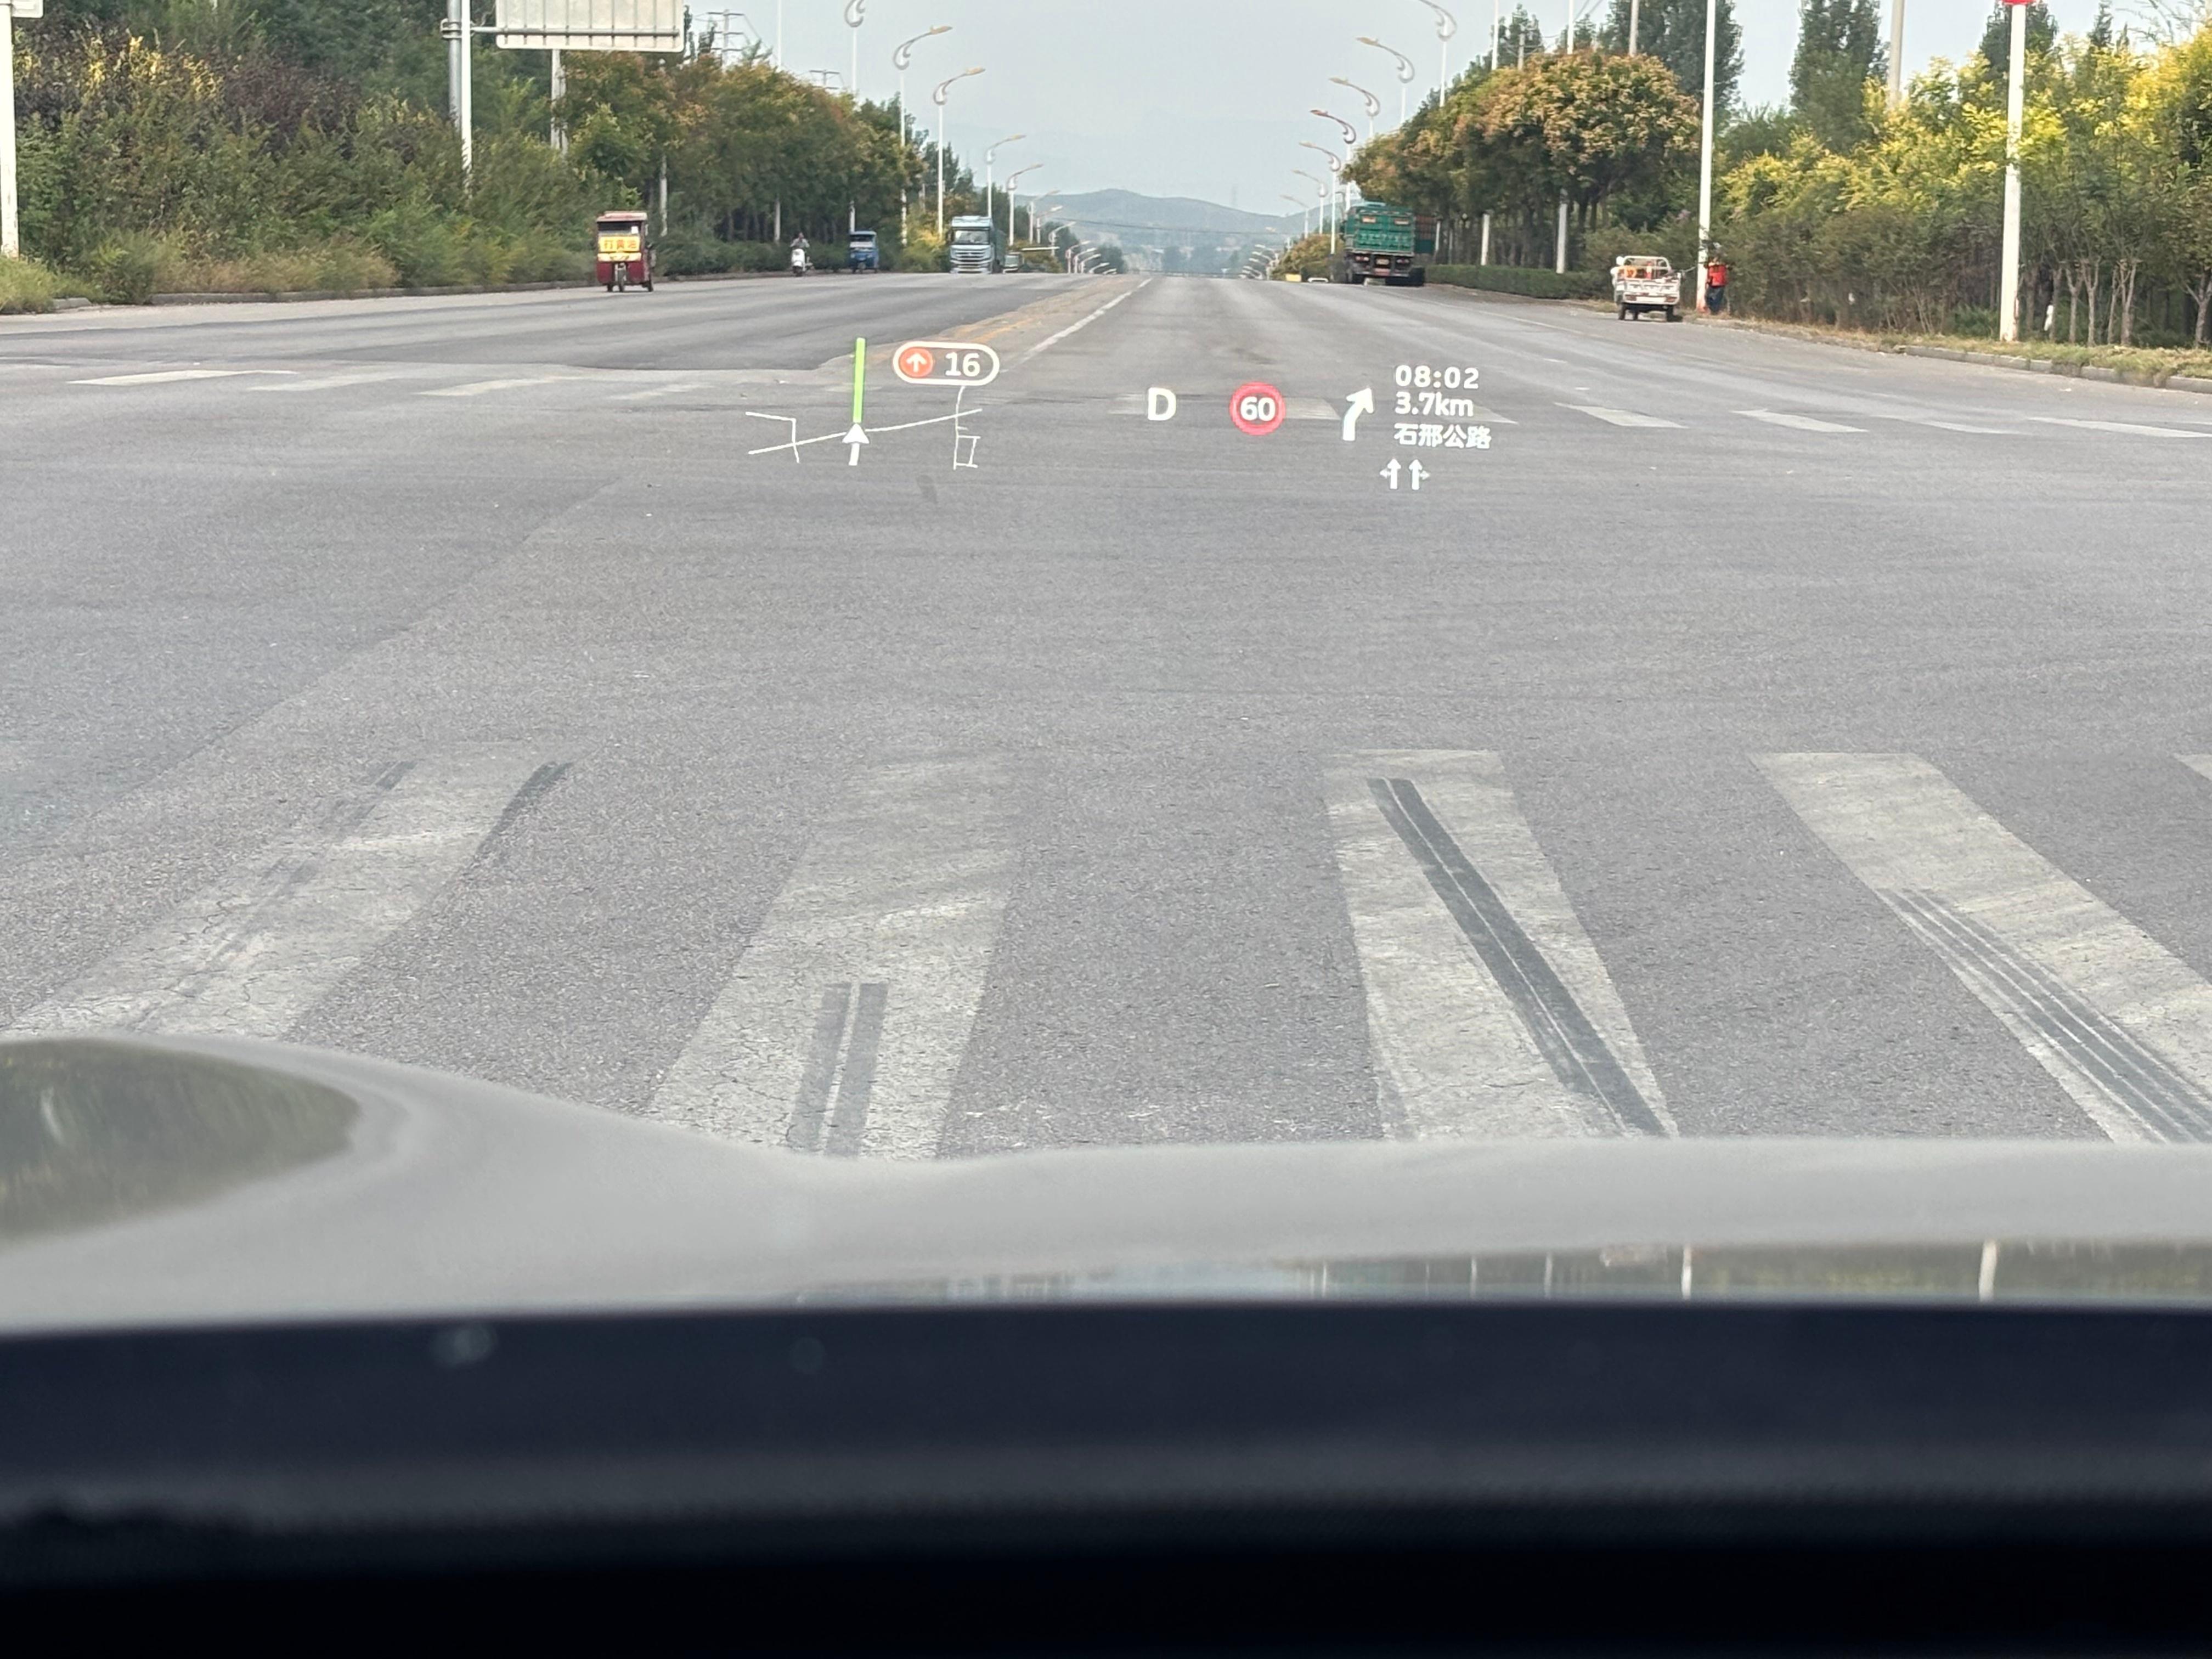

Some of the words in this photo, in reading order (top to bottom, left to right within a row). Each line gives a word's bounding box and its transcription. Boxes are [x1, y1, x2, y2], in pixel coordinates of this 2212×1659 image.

[945, 352, 980, 377] 16
[1395, 364, 1479, 389] 08:02
[1147, 387, 1176, 421] D
[1240, 396, 1276, 421] 60
[1395, 391, 1474, 417] 3.7km
[1393, 422, 1492, 449] 石邢公路
